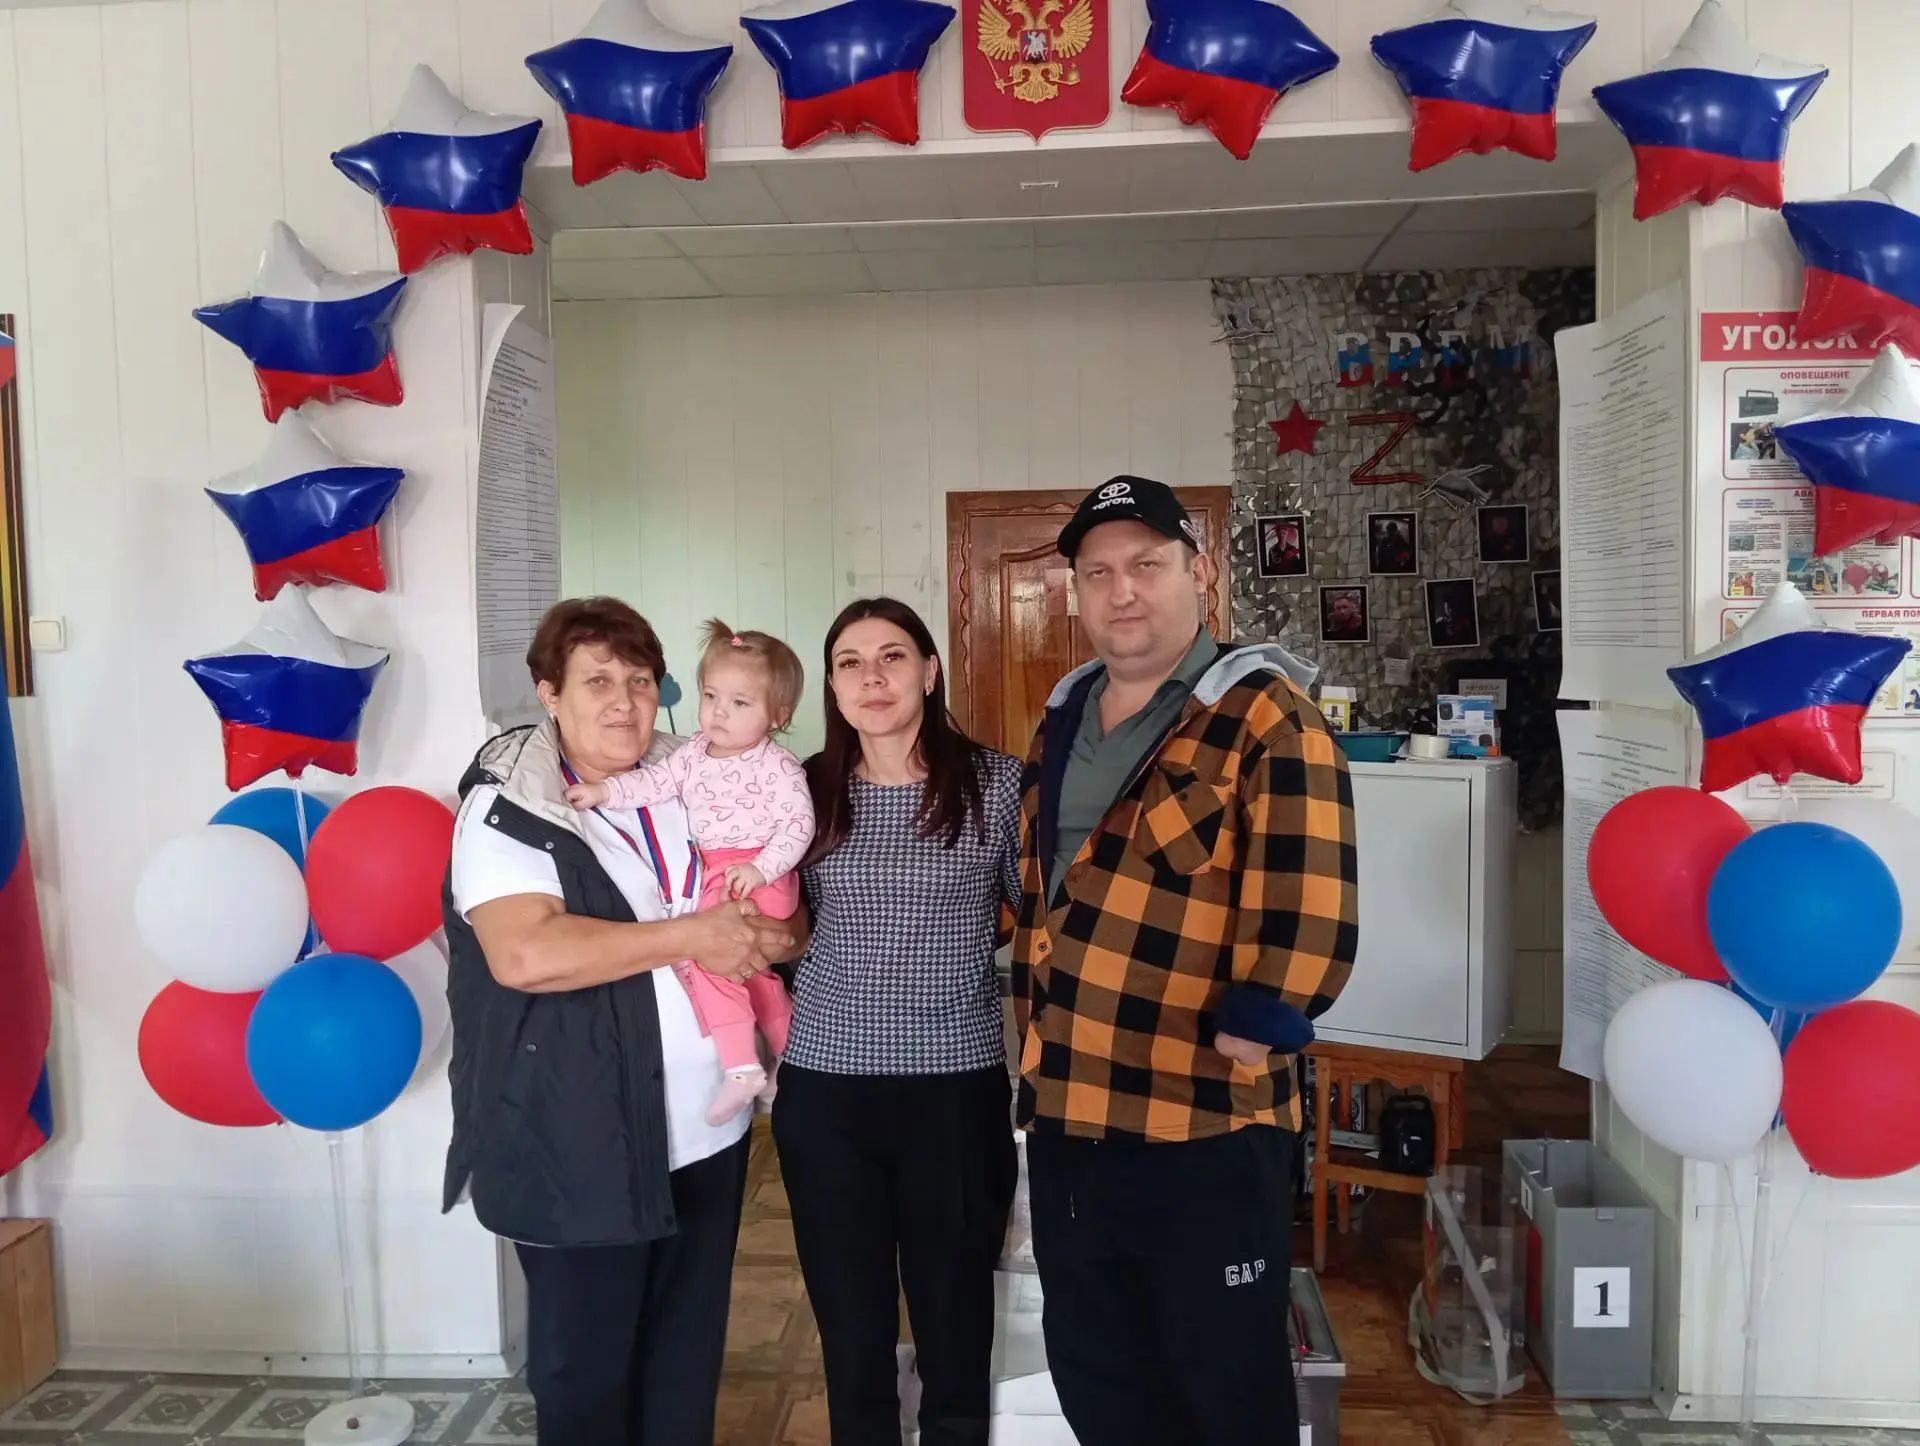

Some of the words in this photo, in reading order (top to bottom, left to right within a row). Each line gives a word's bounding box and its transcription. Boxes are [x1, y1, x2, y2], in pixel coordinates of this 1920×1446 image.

[1092, 497, 1135, 510] TOYOTA
[1862, 610, 1900, 618] ПЕРВАЯ
[1225, 1259, 1266, 1286] GAP
[1593, 1280, 1613, 1316] 1
